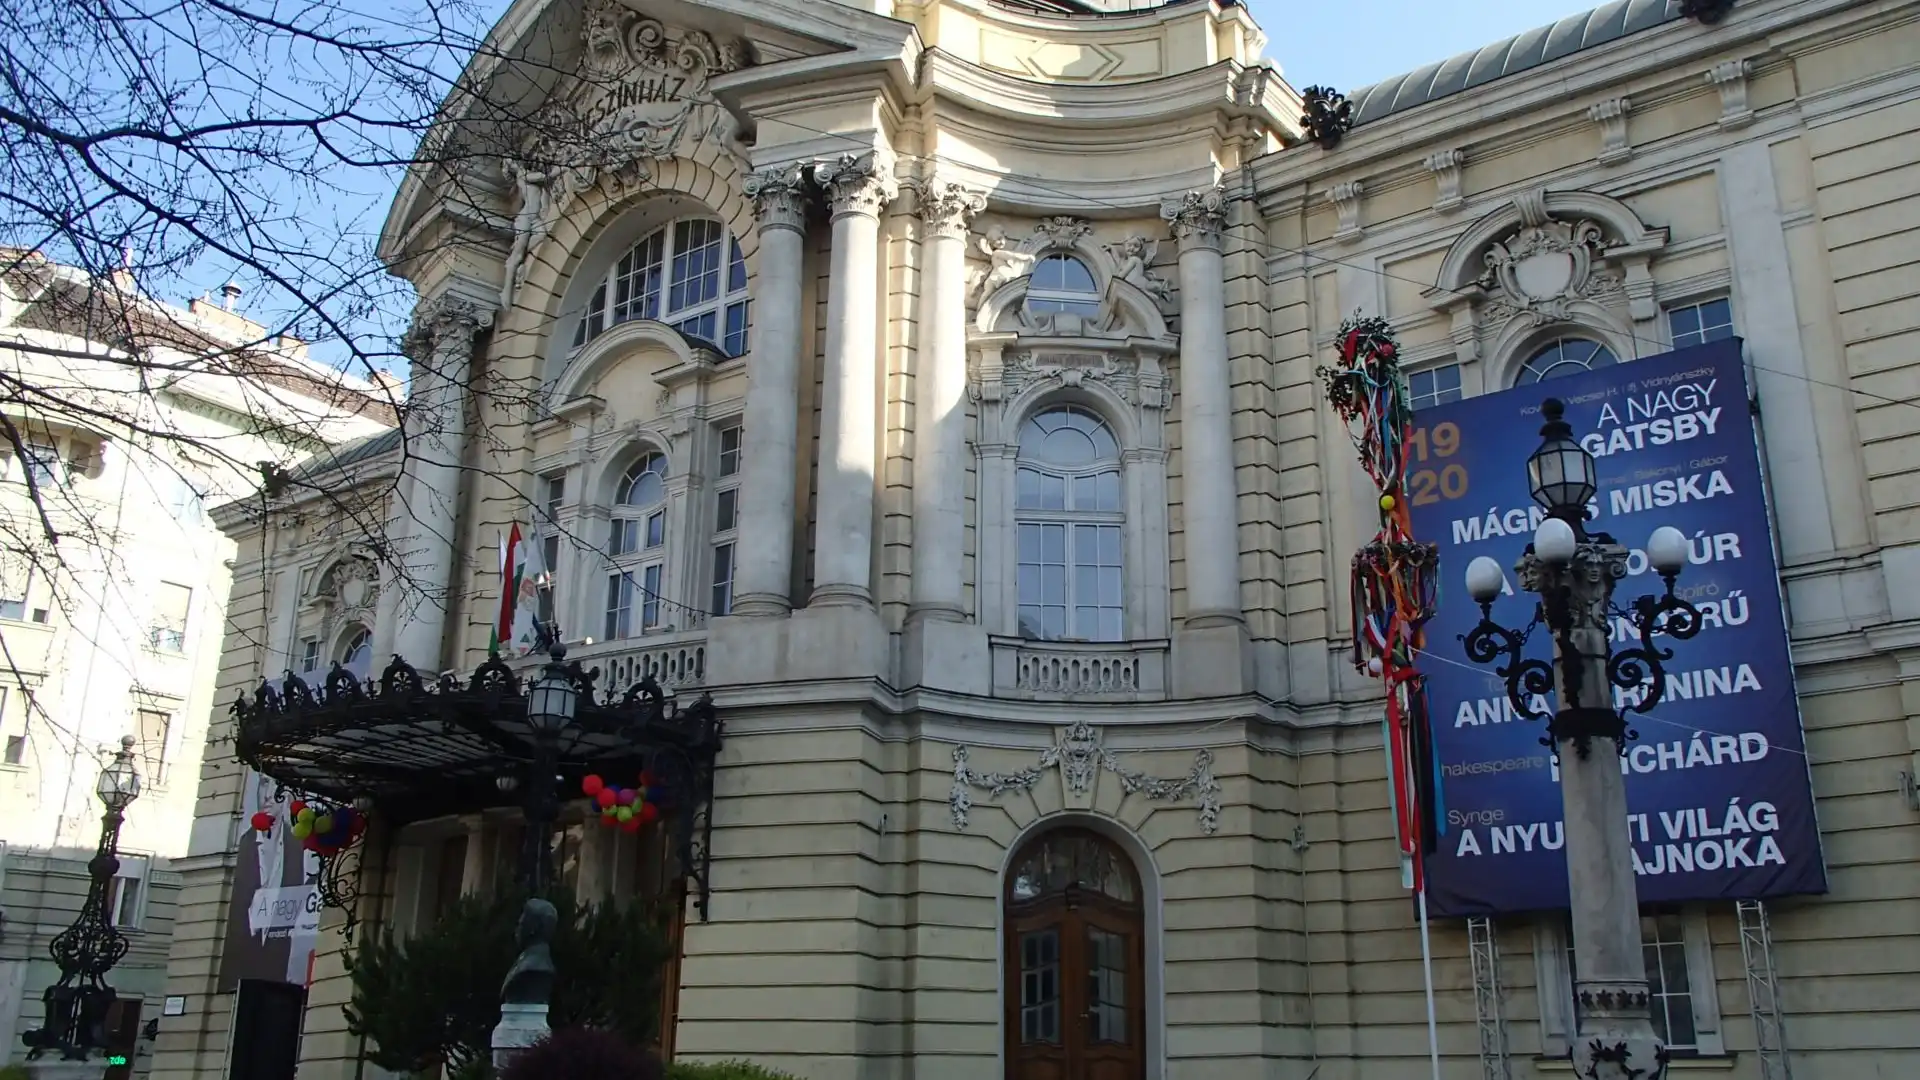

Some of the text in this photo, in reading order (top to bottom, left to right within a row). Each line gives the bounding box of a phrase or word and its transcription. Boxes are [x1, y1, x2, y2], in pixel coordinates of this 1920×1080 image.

[1597, 378, 1718, 429] A NAGY
[1409, 422, 1460, 462] 19
[1580, 406, 1722, 459] GATSBY
[1410, 464, 1468, 507] 20
[1452, 469, 1734, 544] MÁGNS MISKA
[1441, 756, 1544, 777] hakespeare
[1620, 730, 1769, 775] ICHÁRD
[1448, 809, 1505, 827] Synge
[1456, 797, 1780, 857] A NYUTI VILÁG
[1630, 836, 1786, 875] AJNOKA
